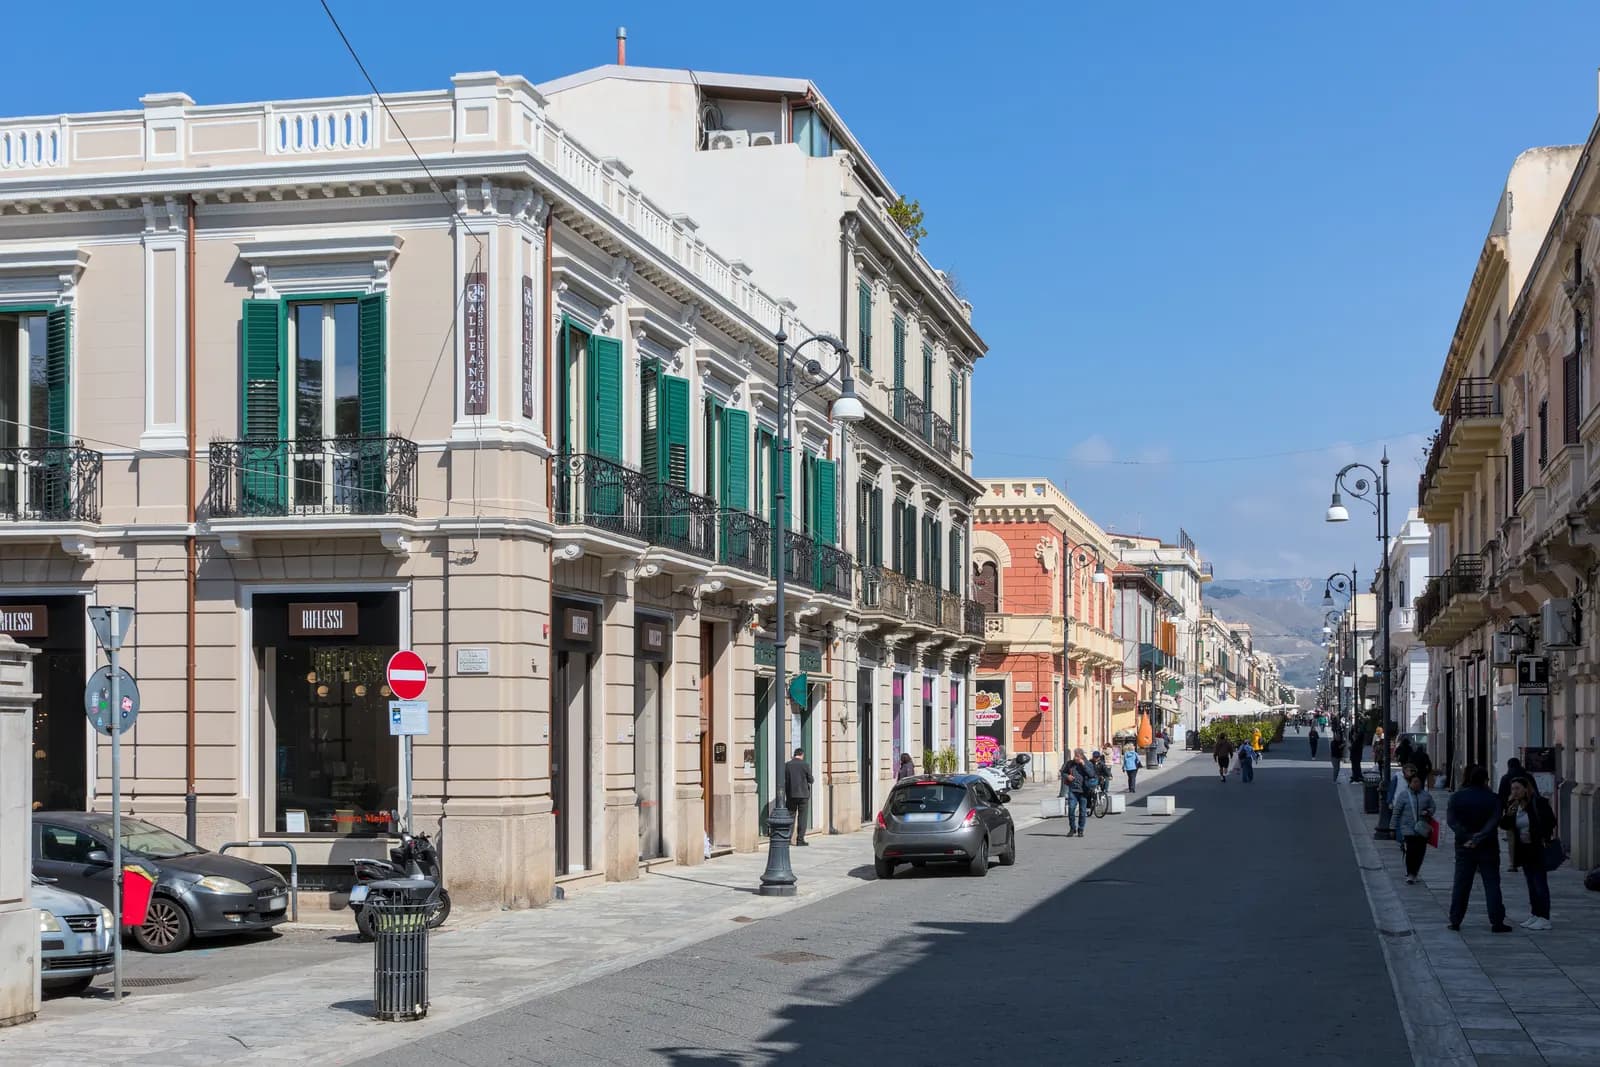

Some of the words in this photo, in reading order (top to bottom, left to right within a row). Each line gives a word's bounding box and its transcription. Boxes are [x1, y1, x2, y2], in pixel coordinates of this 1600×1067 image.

[468, 303, 477, 404] ALLEANZA
[0, 612, 33, 631] FLESSI
[302, 609, 343, 629] RIFLESSI
